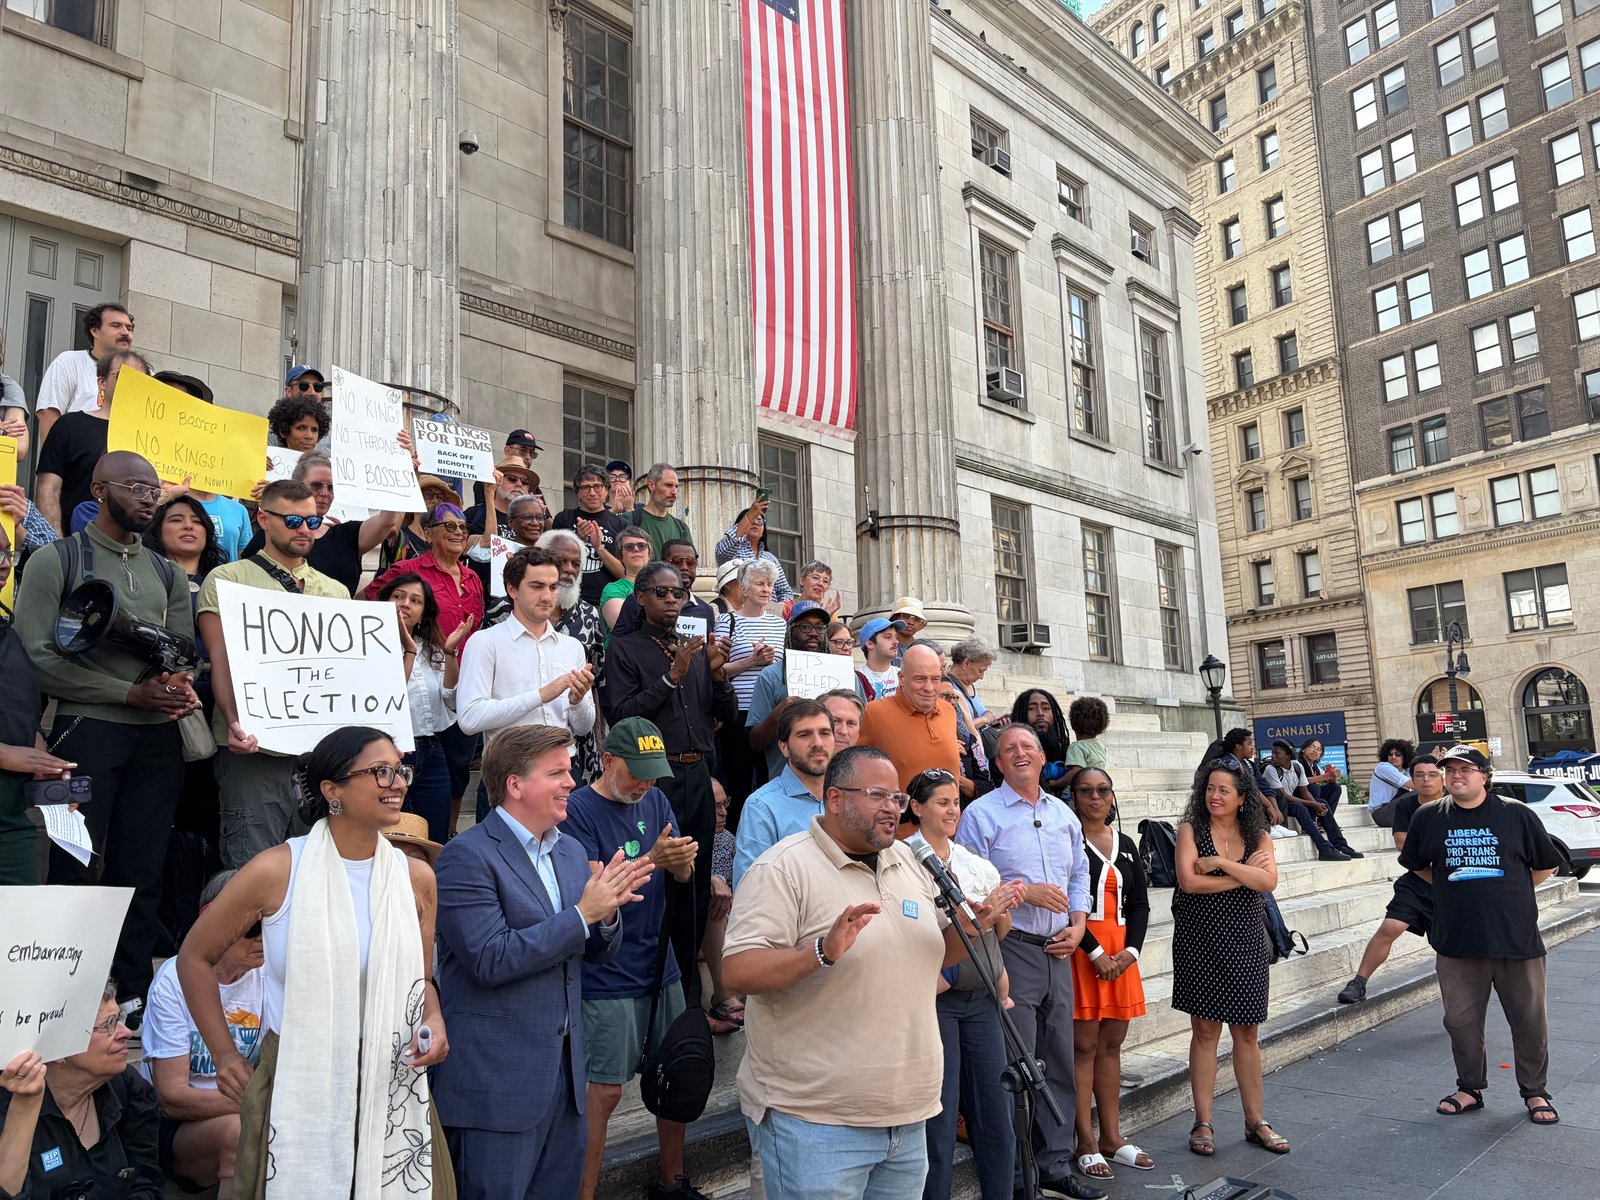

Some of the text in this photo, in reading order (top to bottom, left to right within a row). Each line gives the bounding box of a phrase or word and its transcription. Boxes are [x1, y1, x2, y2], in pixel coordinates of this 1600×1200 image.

[144, 396, 166, 421] NO
[338, 387, 356, 414] NO
[335, 422, 350, 444] NO
[414, 419, 489, 441] NO KINGS
[135, 429, 161, 456] NO
[417, 429, 492, 453] FOR DEMS
[437, 449, 474, 461] BACK OFF
[335, 456, 416, 489] NO BOSSES!
[436, 467, 478, 480] HERMELYN
[242, 602, 392, 656] HONOR
[681, 623, 697, 631] OFF
[287, 667, 335, 685] THE
[788, 672, 841, 690] CALLED
[243, 682, 405, 720] ELECTION
[1266, 723, 1331, 738] CANNABIST
[1444, 836, 1499, 847] CURRENTS
[1447, 828, 1493, 838] LIBERAL
[1446, 846, 1497, 857] PRO-TRANS
[1445, 856, 1501, 867] PRO-TRANSIT
[15, 1009, 32, 1027] be
